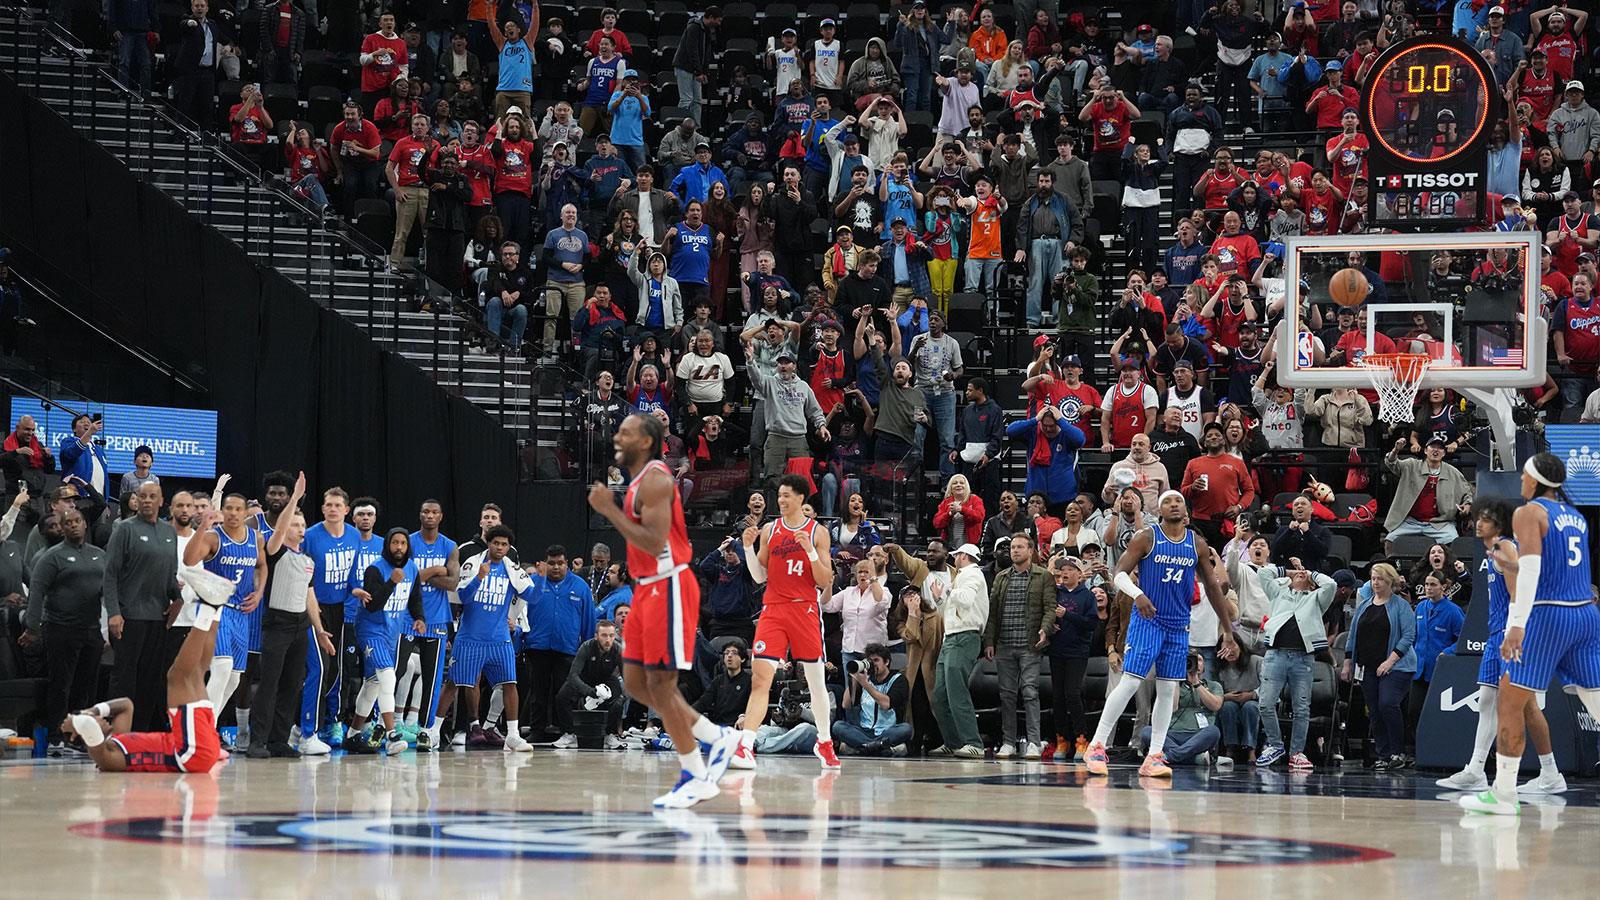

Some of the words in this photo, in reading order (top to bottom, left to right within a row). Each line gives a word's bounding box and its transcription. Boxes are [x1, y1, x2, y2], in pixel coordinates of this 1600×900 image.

[1551, 39, 1571, 48] Angeles
[504, 45, 526, 57] Clips
[817, 49, 836, 58] CLIPPERS
[519, 54, 525, 64] 2
[823, 58, 829, 66] 2
[592, 66, 615, 78] CLIPPERS
[782, 64, 788, 72] 2
[598, 77, 605, 87] 2
[1408, 65, 1450, 93] 0.0
[1534, 85, 1553, 93] Angeles
[1563, 119, 1587, 134] Clips
[1404, 172, 1479, 188] TISSOT
[900, 199, 911, 210] 24
[977, 211, 997, 222] LA
[984, 223, 991, 235] 2
[681, 234, 709, 245] CLIPPERS
[692, 242, 700, 252] 2
[1570, 315, 1600, 330] Clipper
[691, 364, 721, 381] LA
[1131, 415, 1138, 427] 2
[1184, 411, 1198, 423] 55
[1433, 430, 1448, 442] 55
[1568, 536, 1582, 567] 5
[1154, 554, 1195, 567] ORLANDO
[786, 559, 804, 577] 14
[231, 568, 244, 584] 3
[1161, 567, 1185, 584] 34
